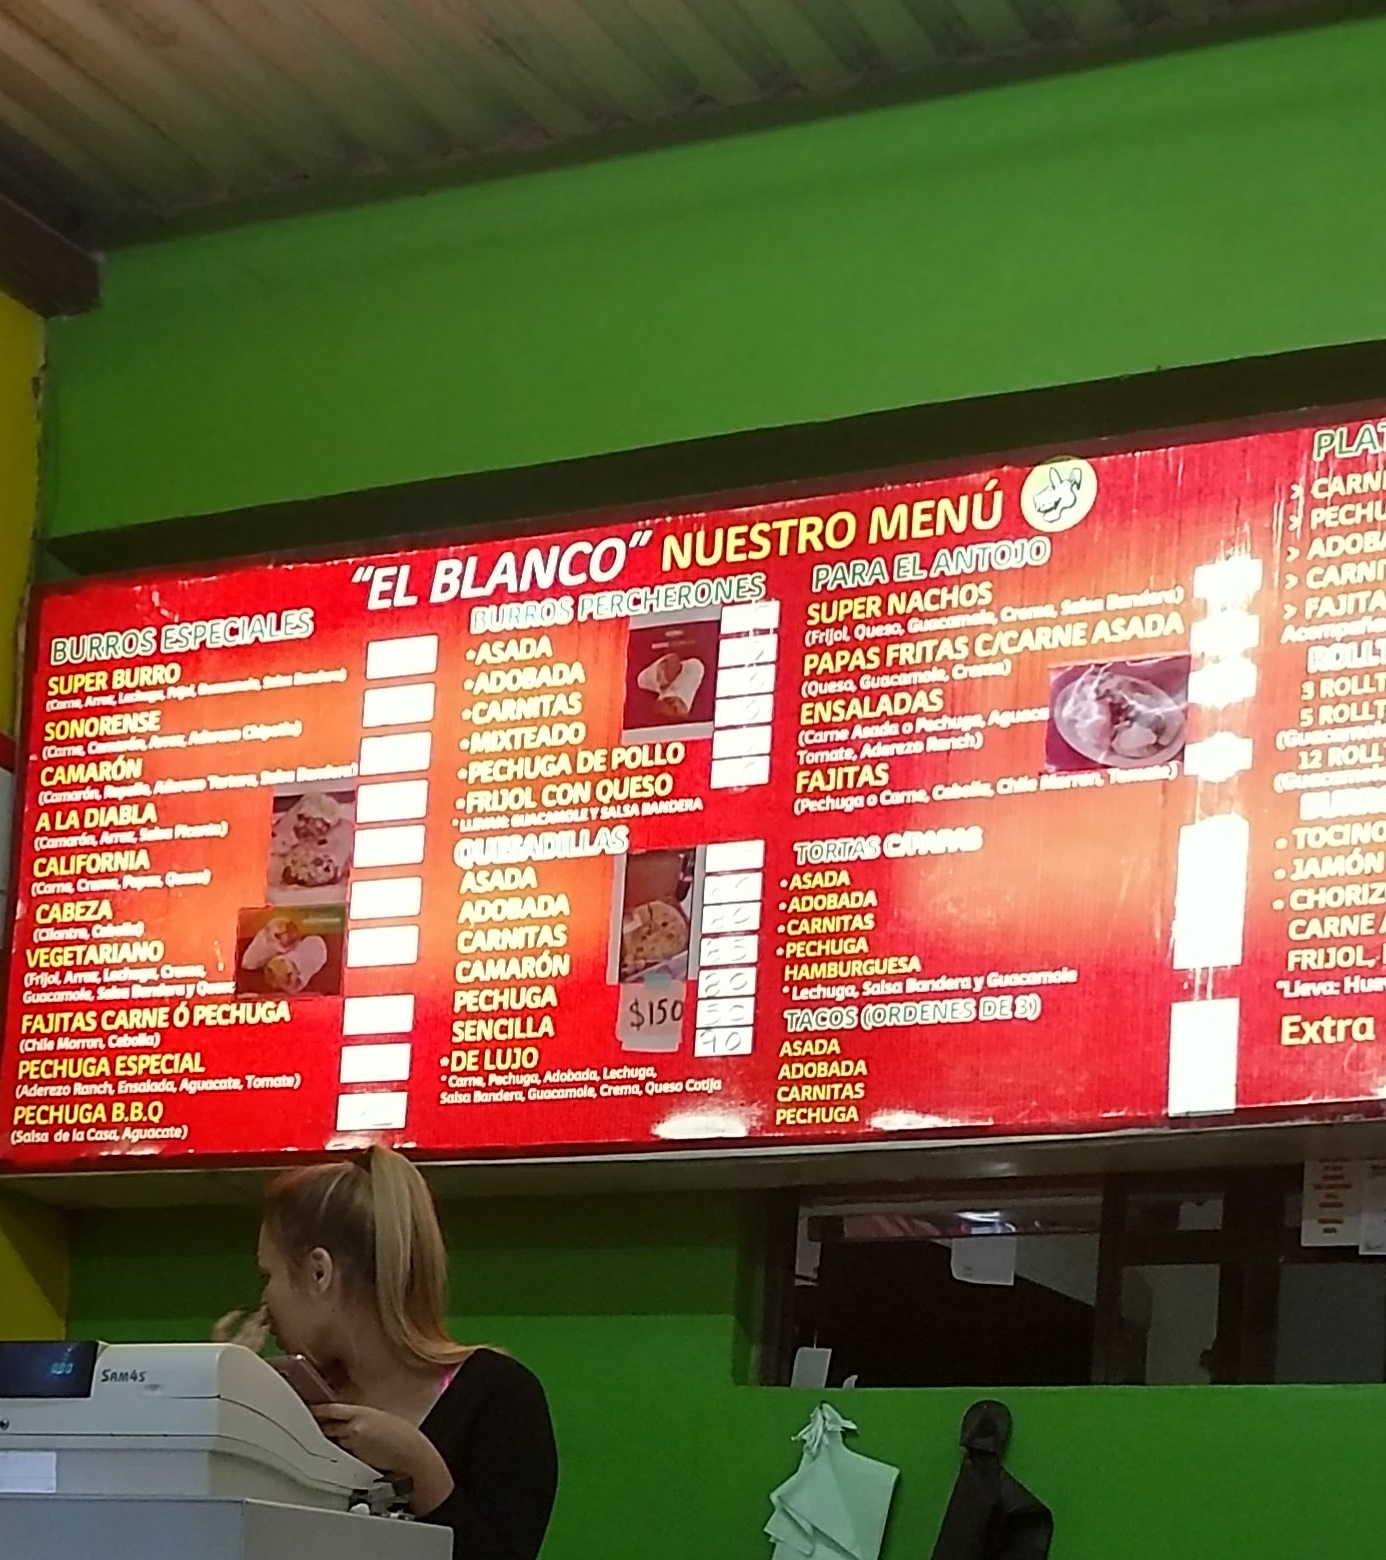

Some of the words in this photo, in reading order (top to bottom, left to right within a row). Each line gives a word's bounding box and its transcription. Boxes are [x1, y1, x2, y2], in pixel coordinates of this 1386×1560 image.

[660, 511, 857, 573] NUESTRO
[868, 478, 1004, 544] MENÚ
[812, 559, 889, 593] PARA
[893, 553, 924, 581] EL
[930, 535, 1051, 578] ANTOJO
[469, 599, 573, 635] BURROS
[577, 572, 767, 622] PERCHERONES
[807, 591, 881, 627] SUPER
[887, 581, 993, 620] NACHOS
[51, 627, 156, 666] BURROS
[161, 608, 315, 654] ESPECIALES
[803, 645, 880, 677] PAPAS
[885, 636, 969, 668] FRITAS
[974, 621, 1087, 662] C/CARNE
[1092, 611, 1184, 645] ASADA
[48, 670, 107, 697] SUPER
[112, 662, 181, 689] BURRO
[800, 689, 944, 727] ENSALADAS
[44, 710, 162, 742] SONORENSE
[40, 757, 143, 788] CAMARÓN
[467, 750, 573, 784] PECHUGA
[576, 748, 607, 774] DE
[611, 742, 685, 770] POLLO
[795, 762, 889, 793] FAJITAS
[465, 786, 537, 814] FRIJOL
[541, 780, 591, 808] CON
[596, 772, 674, 804] QUESO
[36, 812, 51, 832] A
[55, 809, 81, 830] LA
[84, 802, 158, 828] DIABLA
[33, 849, 150, 878] CALIFORNIA
[794, 835, 881, 866] TORTAS
[789, 869, 850, 890] ASADA
[35, 899, 112, 924] CABEZA
[1288, 913, 1375, 942] CARNE
[26, 941, 165, 968] VEGETARIANO
[785, 936, 869, 959] PECHUGA
[1288, 943, 1375, 972] FRIJOL,
[455, 950, 570, 983] CAMARÓN
[784, 956, 921, 981] HAMBURGUESA
[453, 985, 557, 1013] PECHUGA
[21, 1012, 97, 1034] FAJITAS
[101, 1008, 169, 1031] CARNE
[173, 1001, 190, 1027] Ó
[193, 1000, 291, 1027] PECHUGA
[452, 1016, 554, 1043] SENCILLA
[629, 998, 683, 1031] $150
[783, 1005, 859, 1033] TACOS
[861, 998, 977, 1029] (ORDENES
[979, 996, 1013, 1021] DE
[1280, 1014, 1375, 1047] Extra
[450, 1050, 481, 1072] DE
[484, 1047, 539, 1070] LUJO
[779, 1039, 841, 1057] ASADA
[18, 1057, 110, 1079] PECHUGA
[115, 1052, 205, 1076] ESPECIAL
[777, 1059, 868, 1080] ADOBADA
[15, 1082, 71, 1099] (Aderezo
[73, 1081, 114, 1096] Ranch,
[117, 1077, 177, 1095] Ensalada,
[179, 1075, 244, 1093] Aguacate,
[245, 1073, 301, 1089] Tomate)
[776, 1082, 865, 1103] CARNITAS
[13, 1103, 106, 1125] PECHUGA
[111, 1101, 163, 1123] B.B.Q
[775, 1105, 859, 1125] PECHUGA
[11, 1128, 49, 1145] (Salsa
[53, 1128, 69, 1143] de
[72, 1128, 84, 1142] la
[86, 1126, 120, 1143] Casa,
[122, 1124, 188, 1141] Aguacate)
